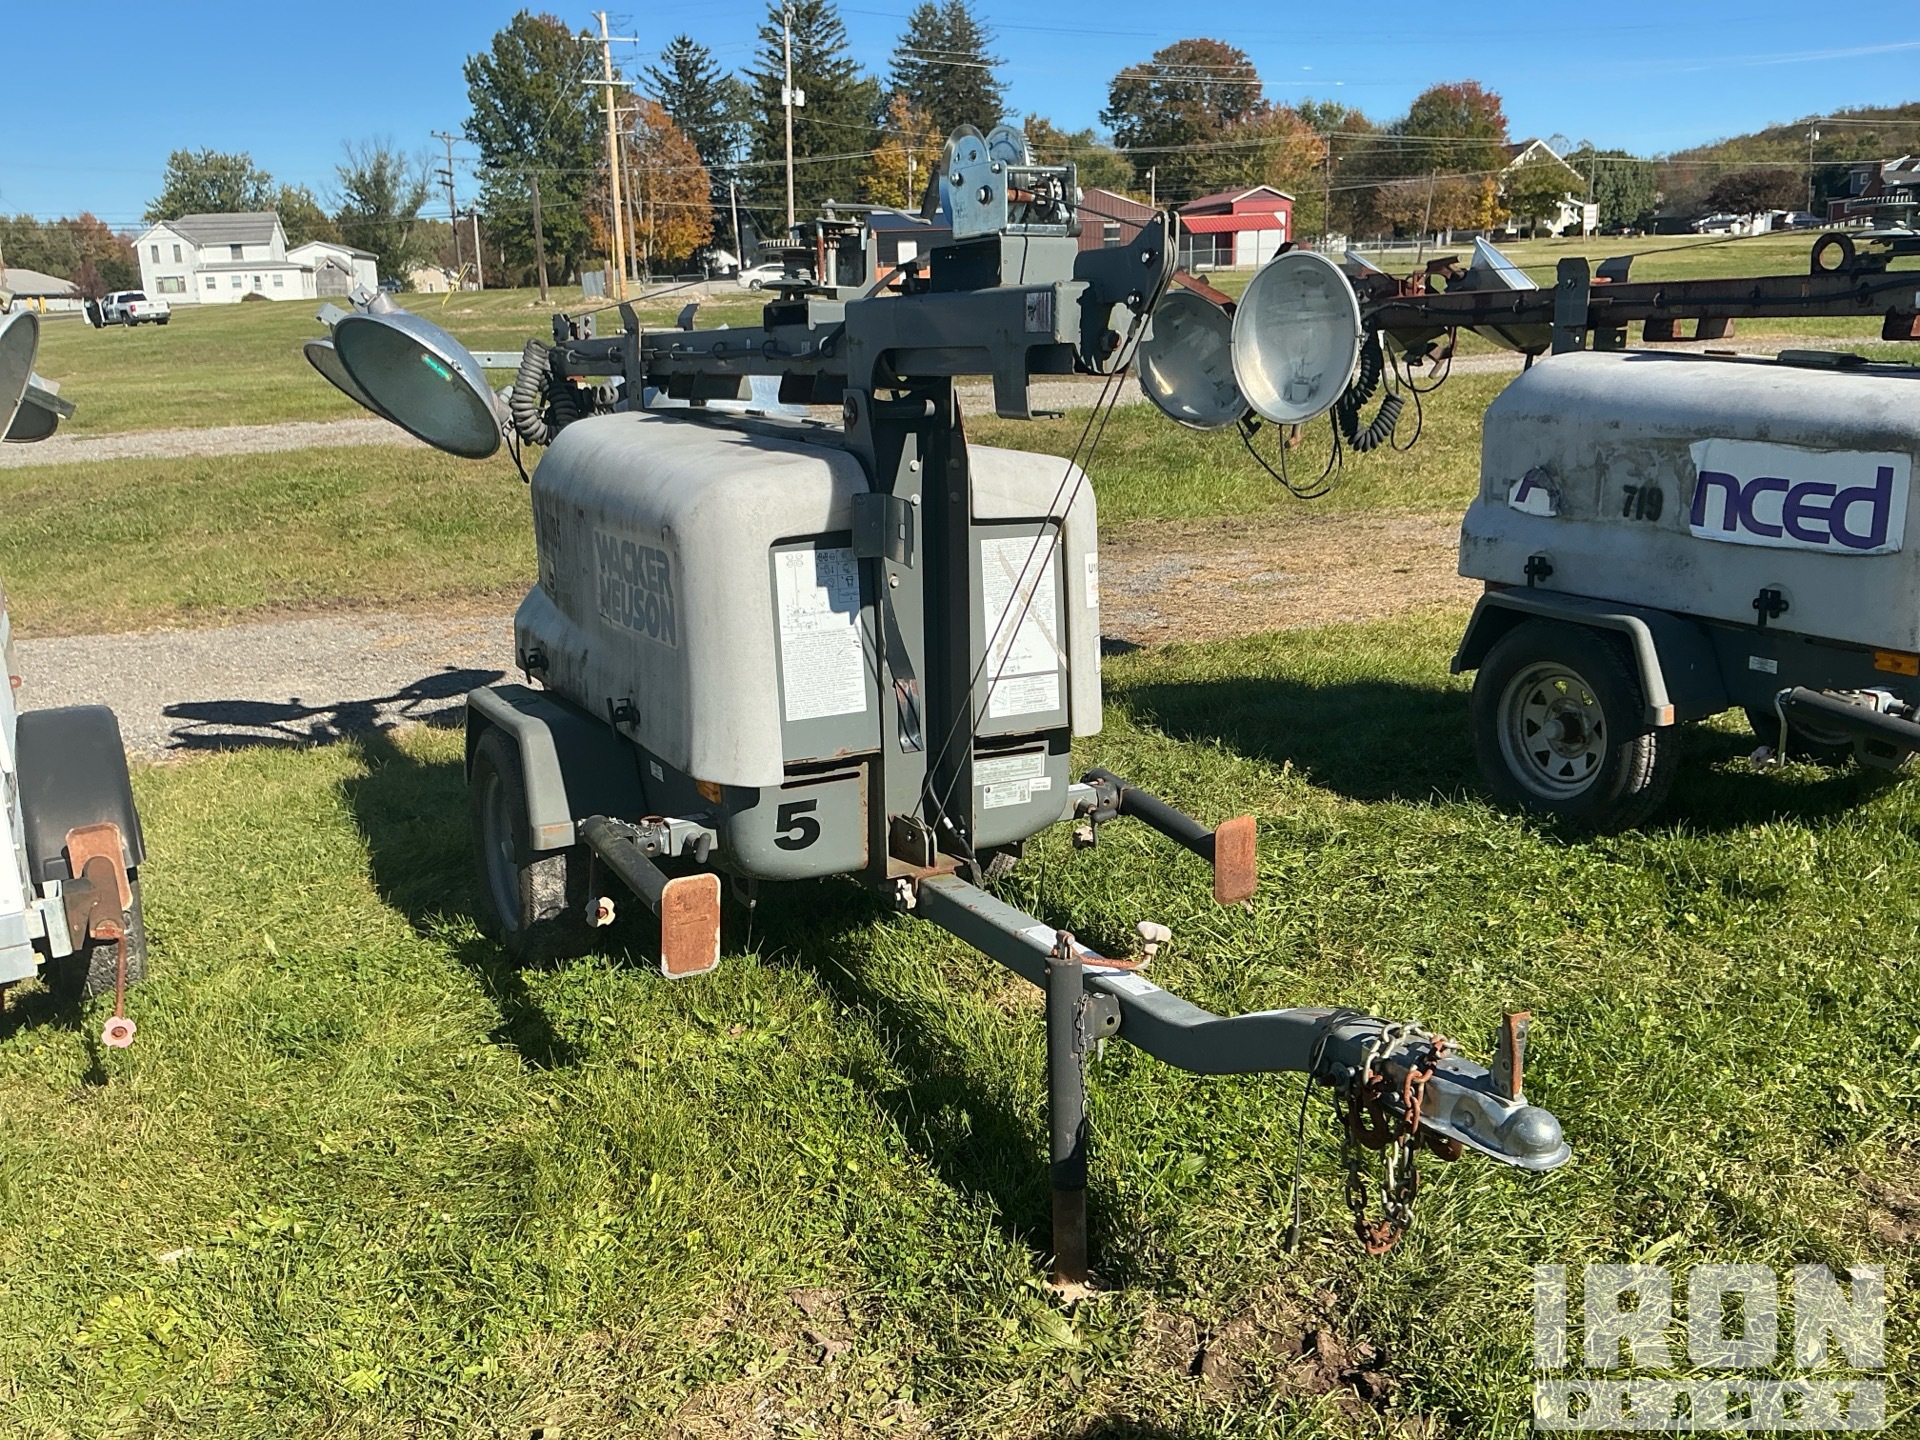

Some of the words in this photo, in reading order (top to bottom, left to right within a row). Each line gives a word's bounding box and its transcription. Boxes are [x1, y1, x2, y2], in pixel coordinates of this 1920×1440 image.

[1623, 485, 1664, 522] 719
[594, 530, 674, 600] WACKER
[599, 573, 676, 646] NEUSON
[773, 799, 821, 851] 5
